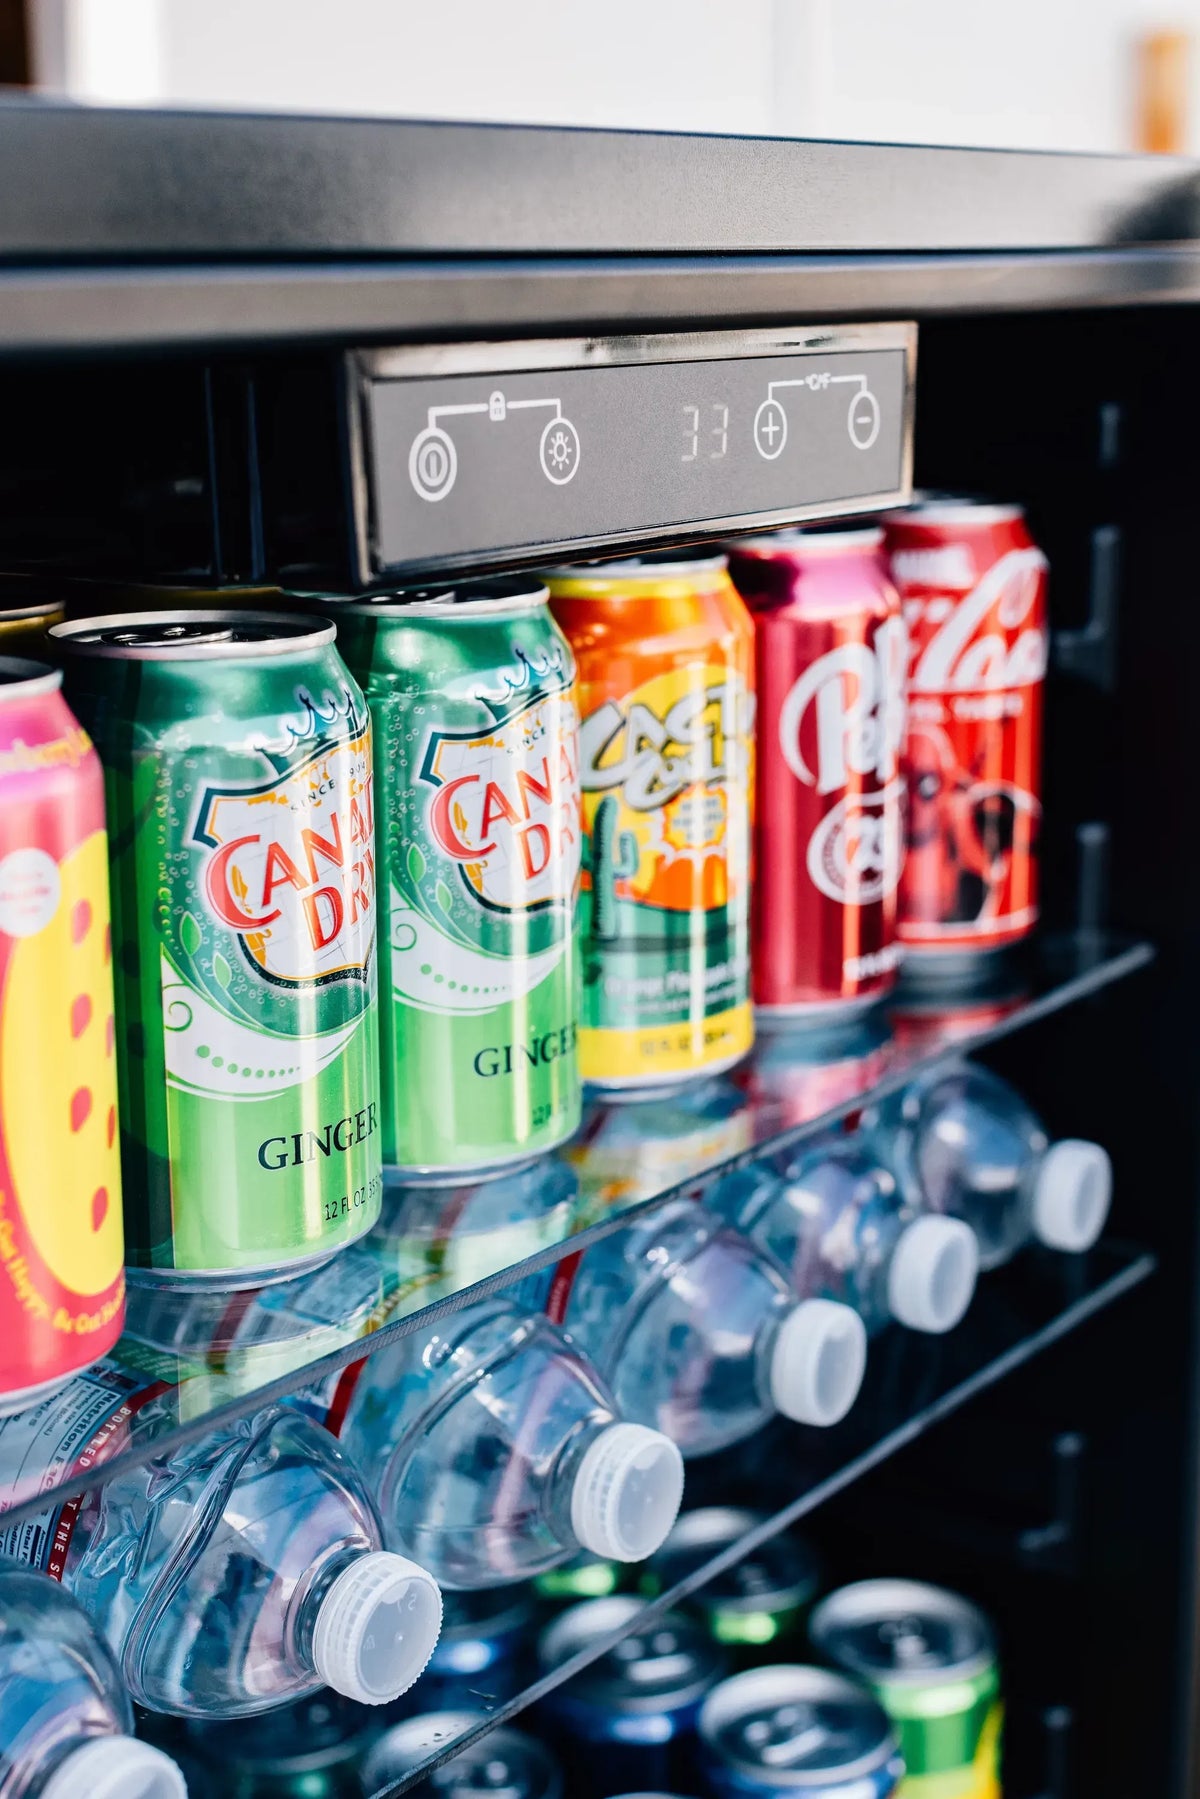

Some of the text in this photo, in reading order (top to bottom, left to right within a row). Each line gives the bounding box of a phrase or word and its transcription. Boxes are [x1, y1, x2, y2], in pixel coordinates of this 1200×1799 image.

[680, 405, 729, 461] 33
[290, 779, 336, 813] SINCE
[257, 1101, 378, 1170] GINGER
[325, 1200, 338, 1221] 12
[341, 1196, 351, 1215] FL
[354, 1186, 366, 1208] OZ
[61, 1393, 117, 1452] Nutrition
[79, 1406, 132, 1467] BOTTLED
[23, 1525, 34, 1550] Total
[54, 1521, 71, 1552] THE
